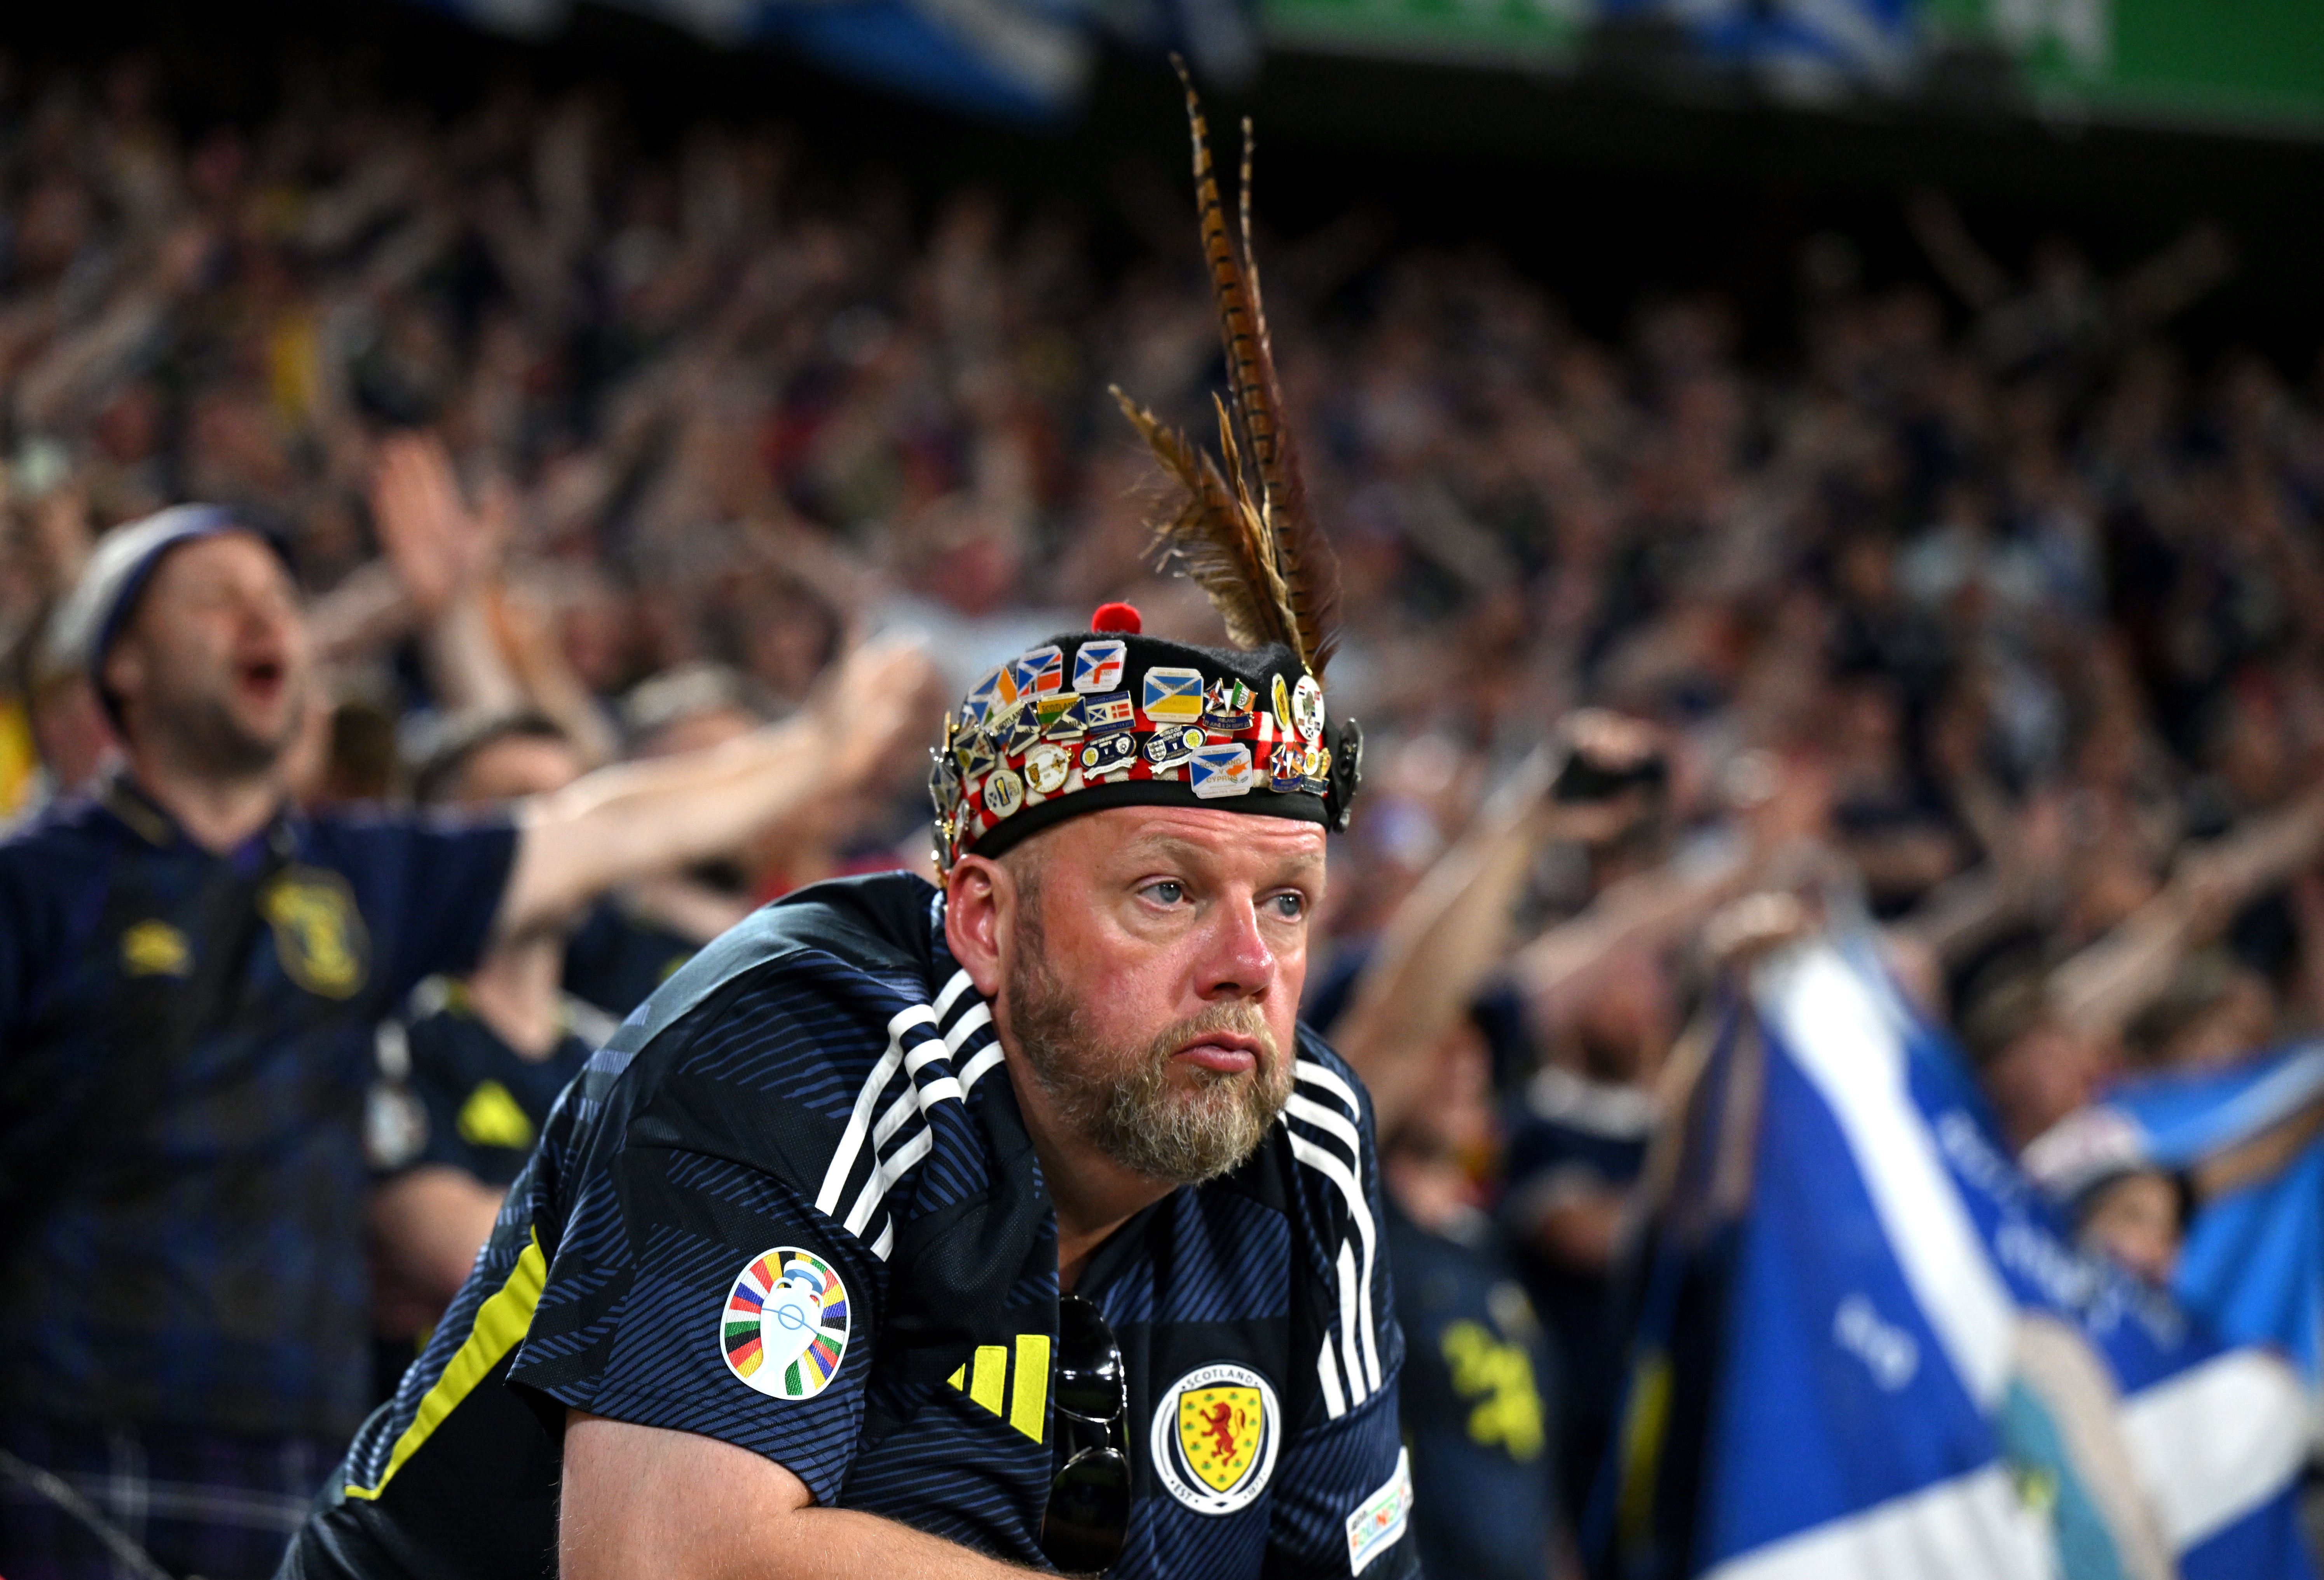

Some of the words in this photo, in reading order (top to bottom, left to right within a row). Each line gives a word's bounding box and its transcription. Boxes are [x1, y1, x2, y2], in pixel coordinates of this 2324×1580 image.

[1042, 701, 1078, 712] SCOTLAND
[1159, 728, 1174, 737] WORLD
[1163, 731, 1183, 741] QUALIFIER
[1200, 759, 1241, 768] SCOTLAND
[1186, 1368, 1253, 1388] SCOTLAND
[1173, 1482, 1191, 1501] EST
